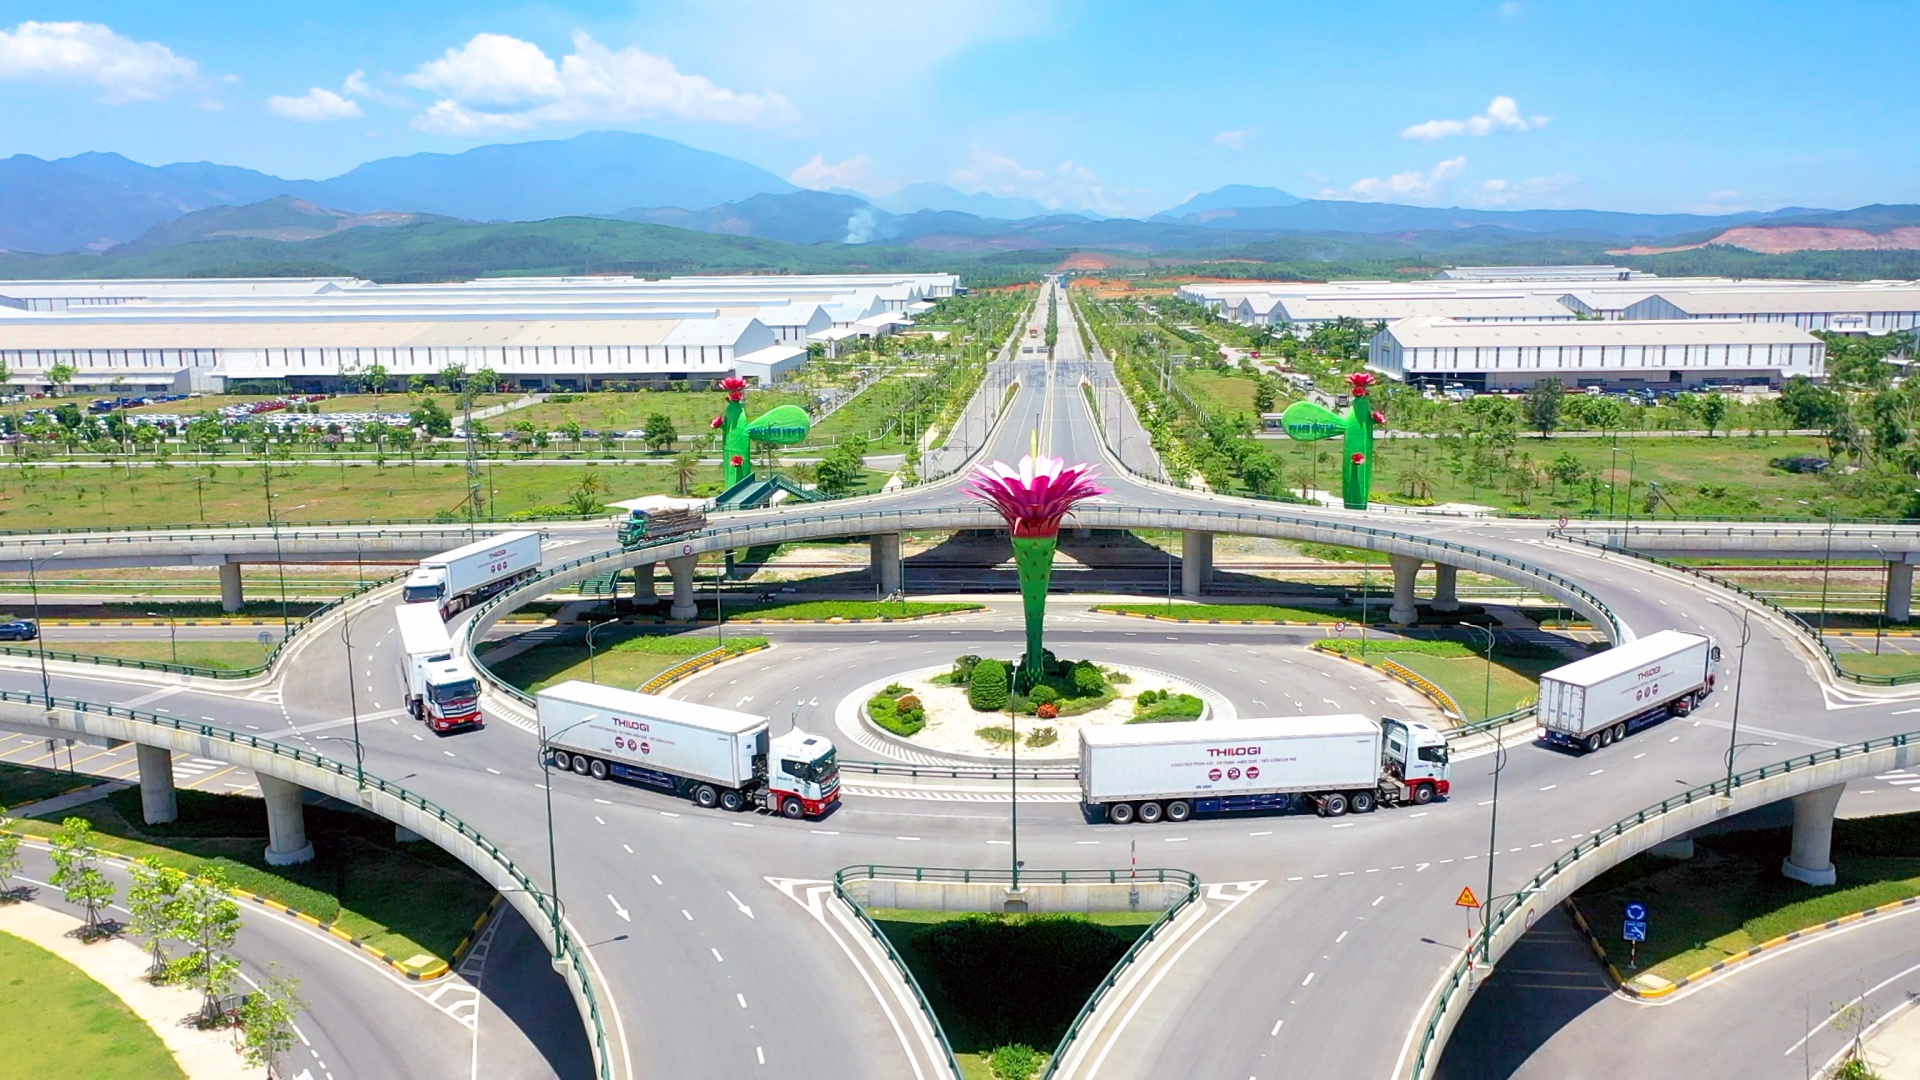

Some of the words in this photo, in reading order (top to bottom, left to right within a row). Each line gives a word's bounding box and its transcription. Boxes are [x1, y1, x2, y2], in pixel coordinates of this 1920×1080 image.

[1637, 666, 1661, 681] THILOGI
[612, 717, 650, 732] THILOGI
[1206, 746, 1261, 757] THILOGI
